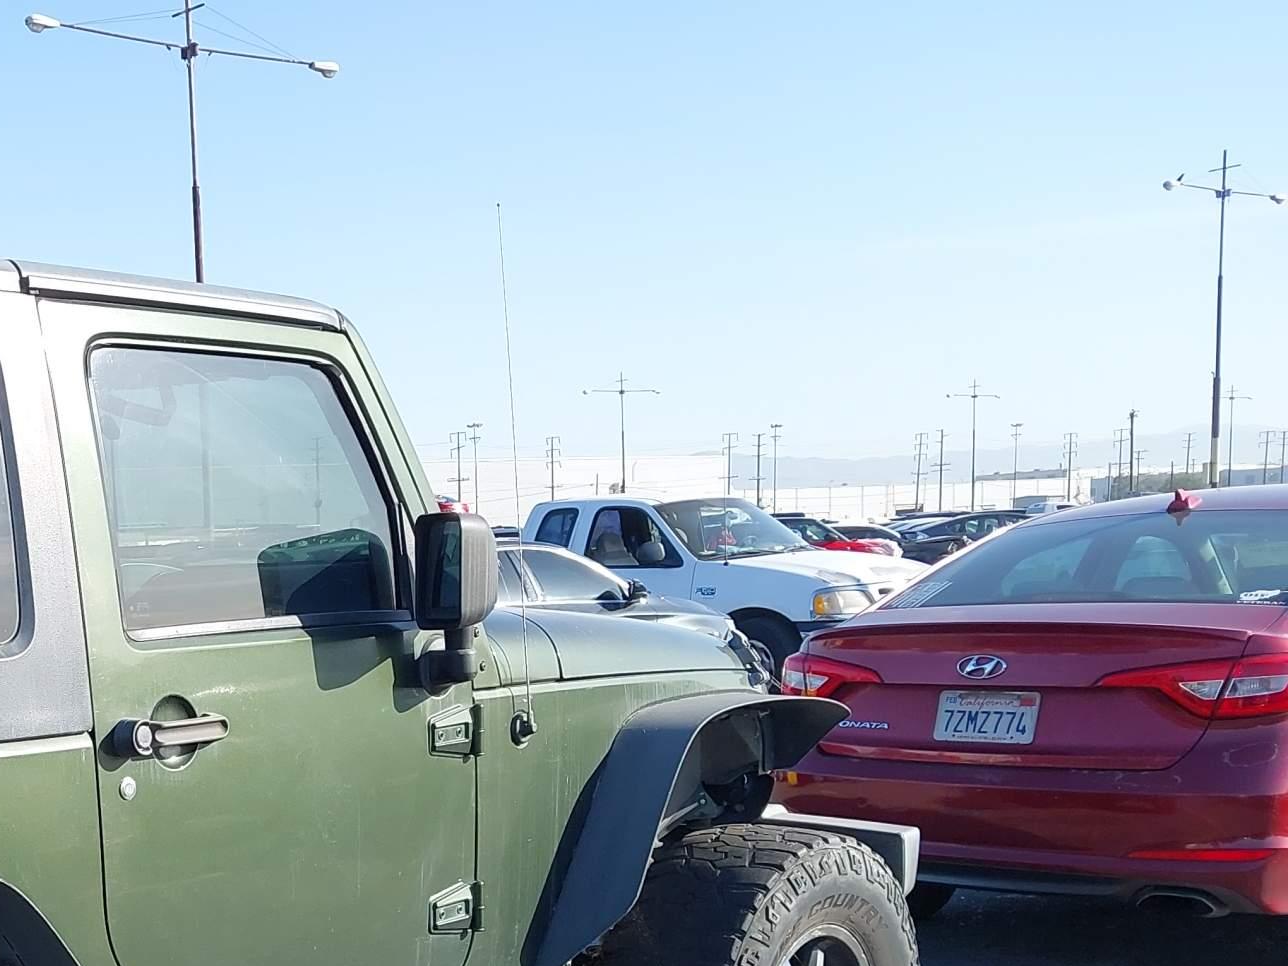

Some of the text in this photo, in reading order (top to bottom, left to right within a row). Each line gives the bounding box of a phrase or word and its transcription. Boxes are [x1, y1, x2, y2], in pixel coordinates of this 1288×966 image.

[959, 696, 1014, 710] California
[838, 720, 889, 730] ONATA
[943, 709, 1027, 735] 7ZMZ774
[808, 893, 889, 929] COUNTRY
